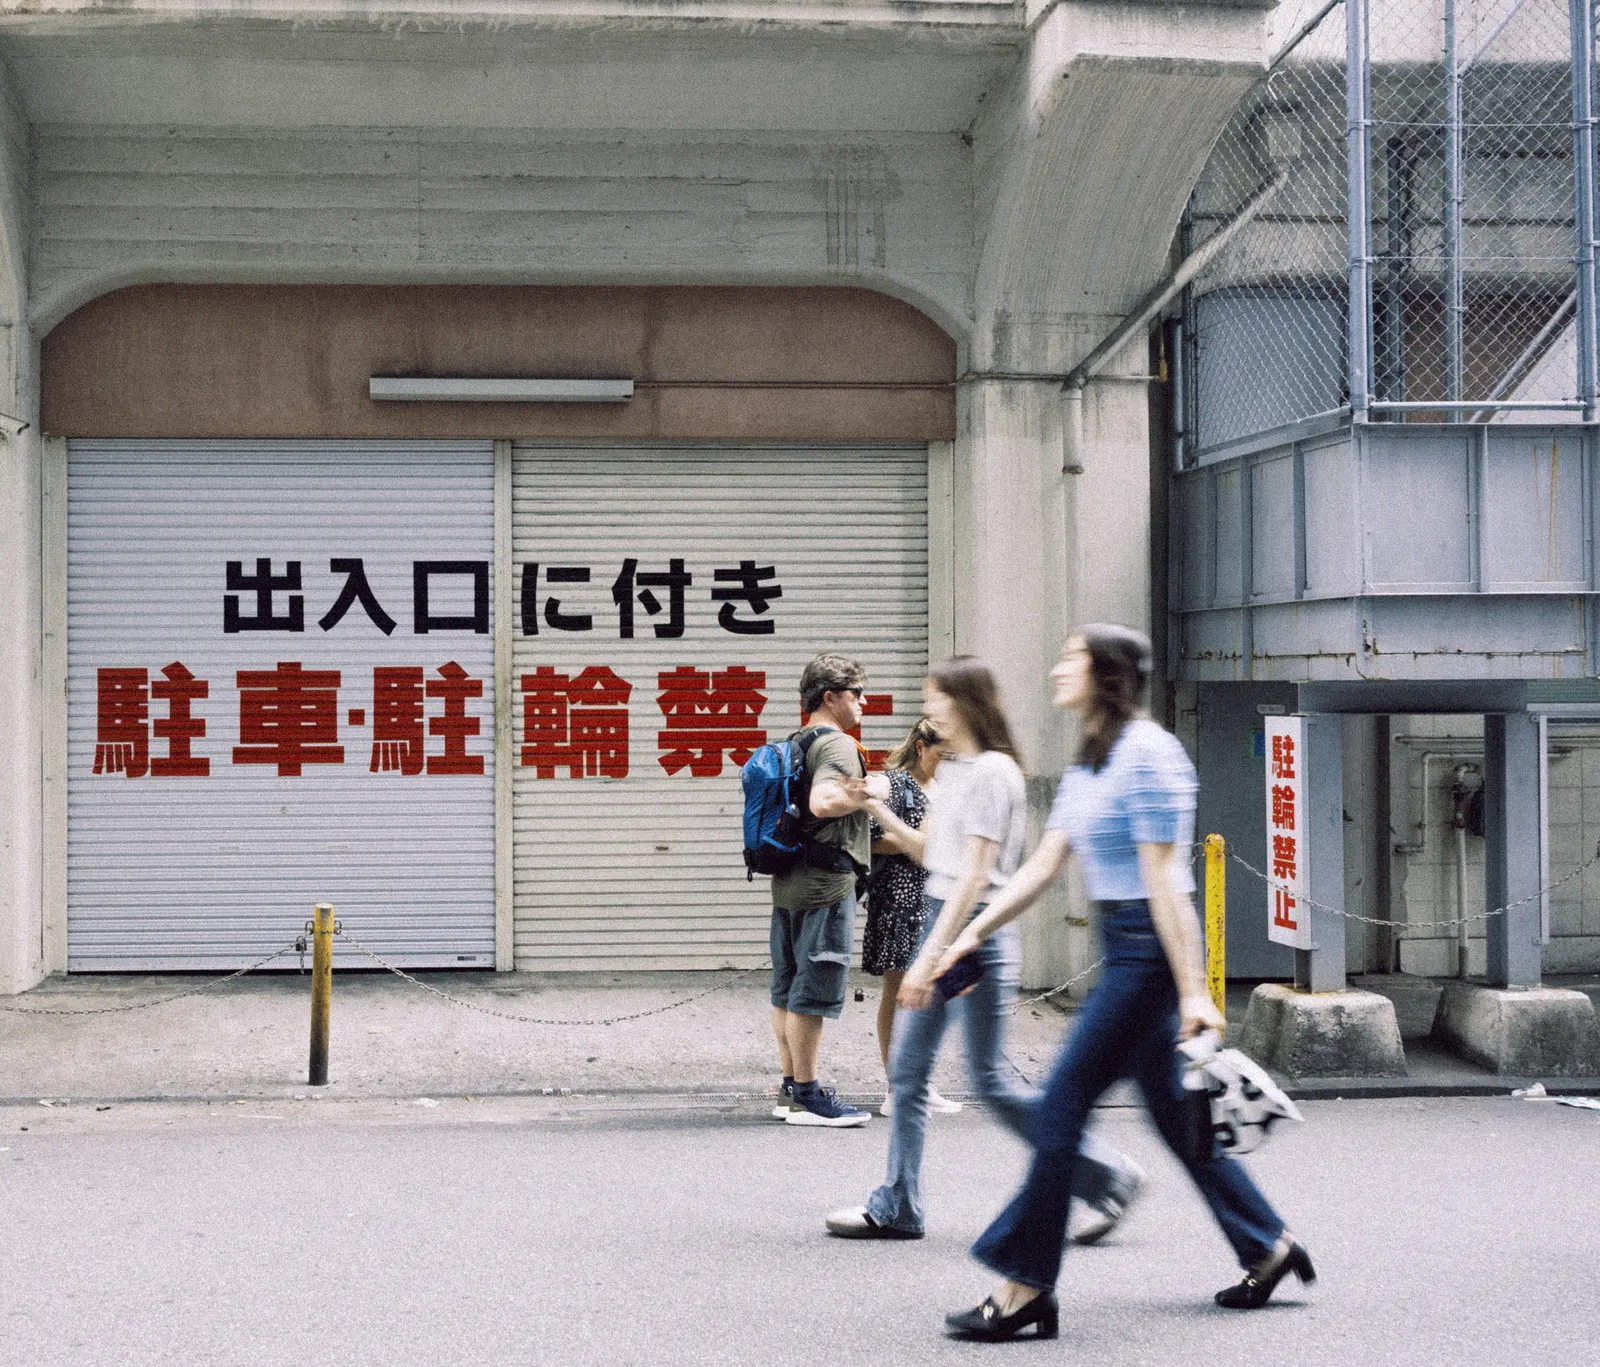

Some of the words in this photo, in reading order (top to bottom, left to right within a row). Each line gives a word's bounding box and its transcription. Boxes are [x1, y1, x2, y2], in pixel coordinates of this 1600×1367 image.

[223, 557, 783, 639] 出入口に付き
[1271, 734, 1298, 931] 駐輪禁止
